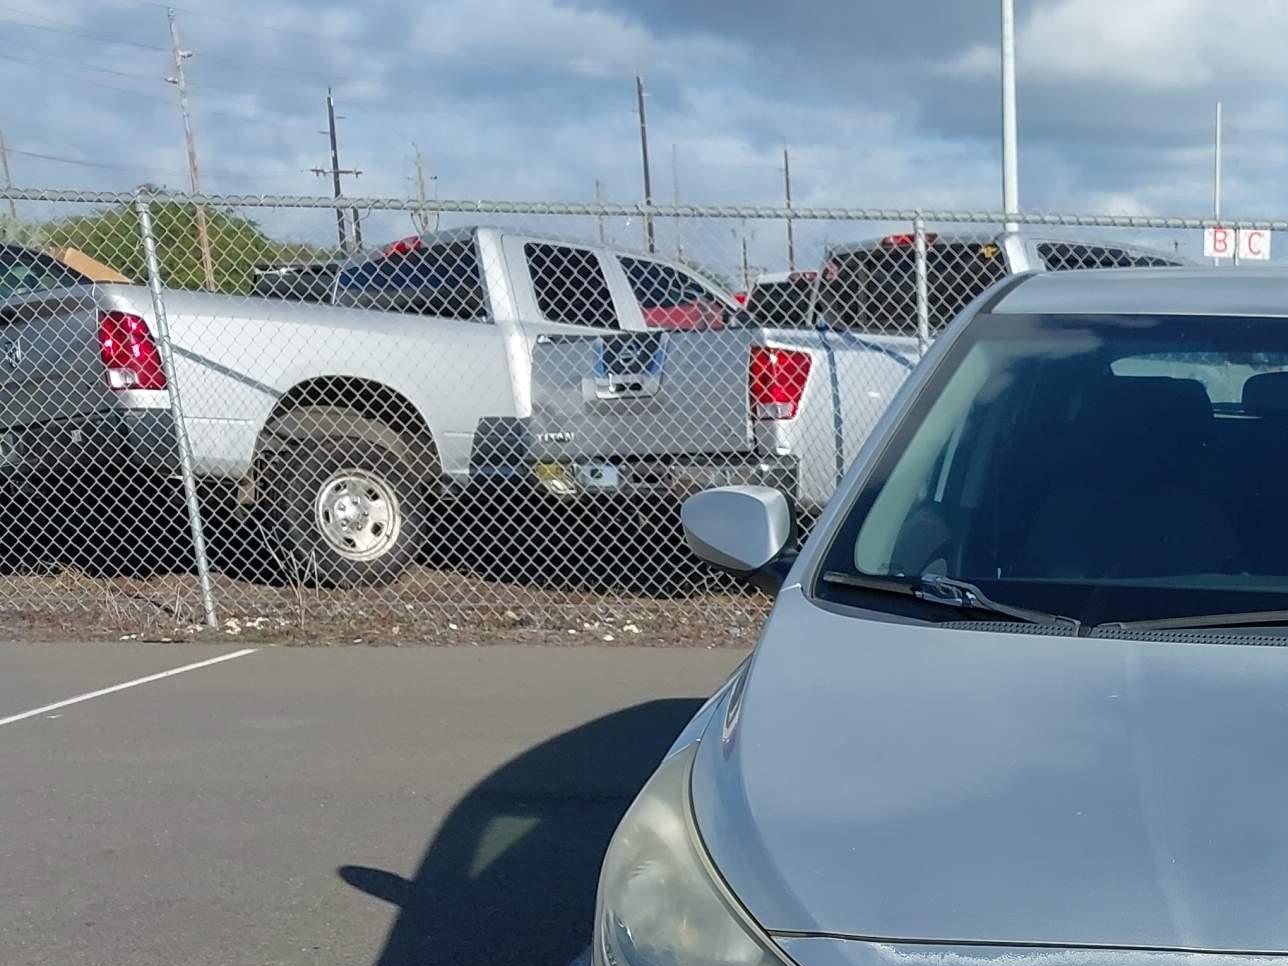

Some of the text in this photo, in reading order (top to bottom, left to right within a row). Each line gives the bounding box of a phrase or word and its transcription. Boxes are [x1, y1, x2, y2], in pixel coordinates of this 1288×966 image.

[1213, 228, 1228, 252] B
[1248, 231, 1262, 255] C
[536, 431, 574, 441] TITAN
